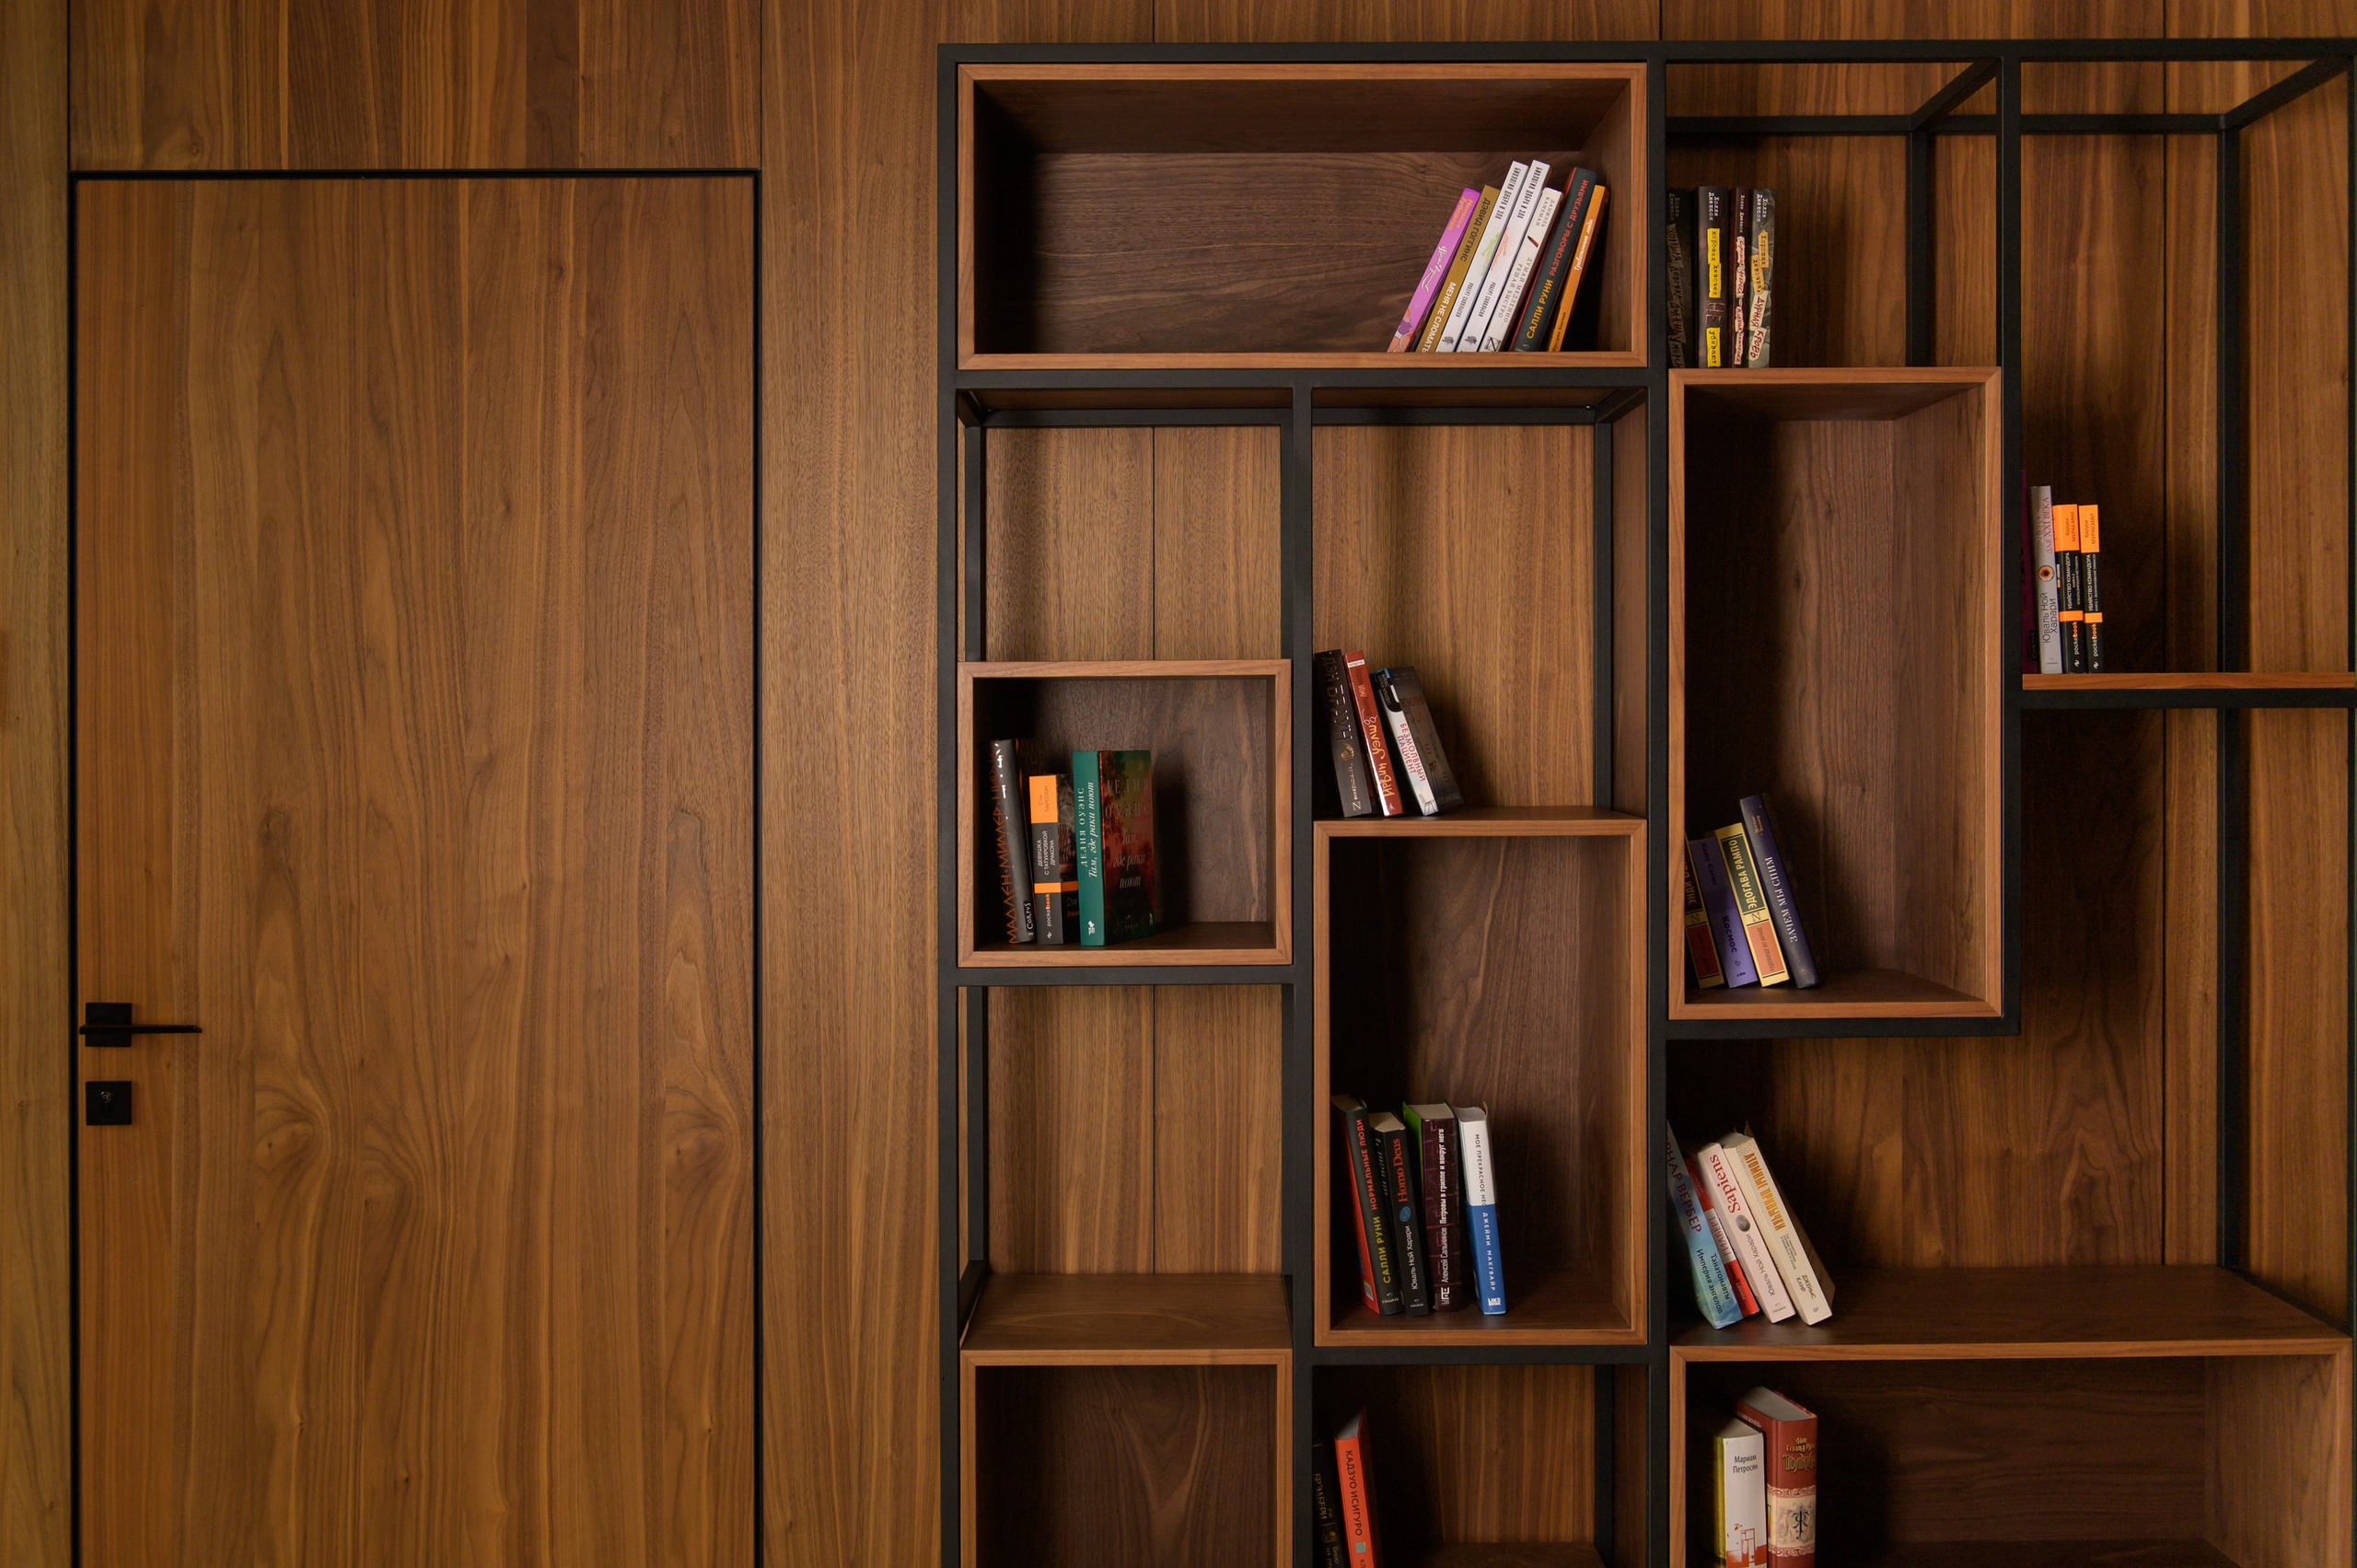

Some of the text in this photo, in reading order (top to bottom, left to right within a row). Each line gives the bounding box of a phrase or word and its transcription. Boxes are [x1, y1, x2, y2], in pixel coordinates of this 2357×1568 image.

[1506, 168, 1521, 190] БИОЛОГИЯ
[1528, 167, 1543, 190] БИОЛОГИЯ
[1446, 196, 1469, 230] Зубарева
[1455, 199, 1474, 227] Наталья
[1500, 191, 1512, 205] ДОБРА
[1521, 190, 1534, 205] ДОБРА
[1535, 197, 1550, 226] КАНЕМАН
[1540, 199, 1555, 227] ДАНИЭЛЬ
[1459, 198, 1492, 261] ДЭВИД ГОГГИНС
[1494, 210, 1504, 219] ЗЛА
[1516, 209, 1527, 219] ЗЛА
[1549, 230, 1571, 276] РАЗГОВОРЫ
[1569, 180, 1589, 221] ДРУЗЬЯМИ
[1518, 257, 1534, 282] ДУМАЙ
[1442, 282, 1457, 304] МЕНЯ
[1455, 283, 1475, 318] РОБЕРТ САПОЛЬСКИ
[1477, 282, 1497, 317] РОБЕРТ САПОЛЬСКИ
[1497, 263, 1524, 318] РЕШАЙ БЫСТРО
[1436, 305, 1447, 315] НЕ
[1526, 279, 1554, 339] САЛЛИ РУНИ
[1709, 331, 1717, 364] убивают
[2042, 496, 2050, 519] ВЕКА
[2035, 509, 2044, 543] 21 УРОК
[2043, 521, 2051, 537] XXI
[2040, 593, 2050, 643] Юваль Ной
[2049, 598, 2058, 633] Харари
[2072, 621, 2080, 655] pocketbook
[1321, 656, 1353, 742] ДЭН БРАУН
[1396, 735, 1416, 773] ПАЦИЕНТ
[1399, 723, 1426, 782] БЕЗМОЛВНЫЙ
[1087, 812, 1097, 837] раки
[1088, 838, 1097, 854] где
[1113, 853, 1146, 871] где раки
[1700, 842, 1712, 862] Карл
[1088, 857, 1098, 877] Там,
[1119, 876, 1142, 889] поют
[1728, 839, 1758, 910] ЭДОГАВА РАМПО
[1685, 880, 1697, 904] ЭНДИ
[1765, 856, 1799, 943] ЗАЧЕМ МЫ СПИМ
[1721, 916, 1738, 954] Космос
[1757, 926, 1766, 941] МРАКЕ
[1763, 947, 1776, 972] ЧУДОВИЩЕ
[1356, 1118, 1378, 1211] НОРМАЛЬНЫЕ ЛЮДИ
[1390, 1138, 1409, 1202] Homo Deus
[1438, 1144, 1446, 1164] вокруг
[1439, 1170, 1447, 1191] гриппе
[1475, 1150, 1485, 1193] ПРЕКРАСНОЕ
[1709, 1154, 1742, 1214] Sapiens
[1744, 1151, 1786, 1232] АТОМНЫЕ ПРИВЫЧКИ
[1440, 1198, 1448, 1224] Петровы
[1676, 1182, 1702, 1235] ВЕРБЕР
[1373, 1216, 1391, 1283] САЛЛИ РУНИ
[1439, 1227, 1448, 1258] Сальников
[1482, 1212, 1495, 1291] ДЖЕЙМИ МАКГВАЙР
[1708, 1214, 1731, 1257] ГИЛБЕРТ
[1404, 1225, 1419, 1289] Юваль Ной Харари
[1440, 1259, 1449, 1283] Алексей
[1744, 1232, 1776, 1296] Юваль Ной Харари
[1694, 1249, 1724, 1314] Империя ангелов
[1709, 1253, 1733, 1301] Танатонавты
[1795, 1277, 1806, 1293] КЛИР
[1802, 1273, 1817, 1299] ДЖЕЙМС
[1733, 1464, 1759, 1473] Петросян
[1735, 1455, 1757, 1464] Мариам
[1345, 1450, 1363, 1536] КАДЗУО ИСИГУРО
